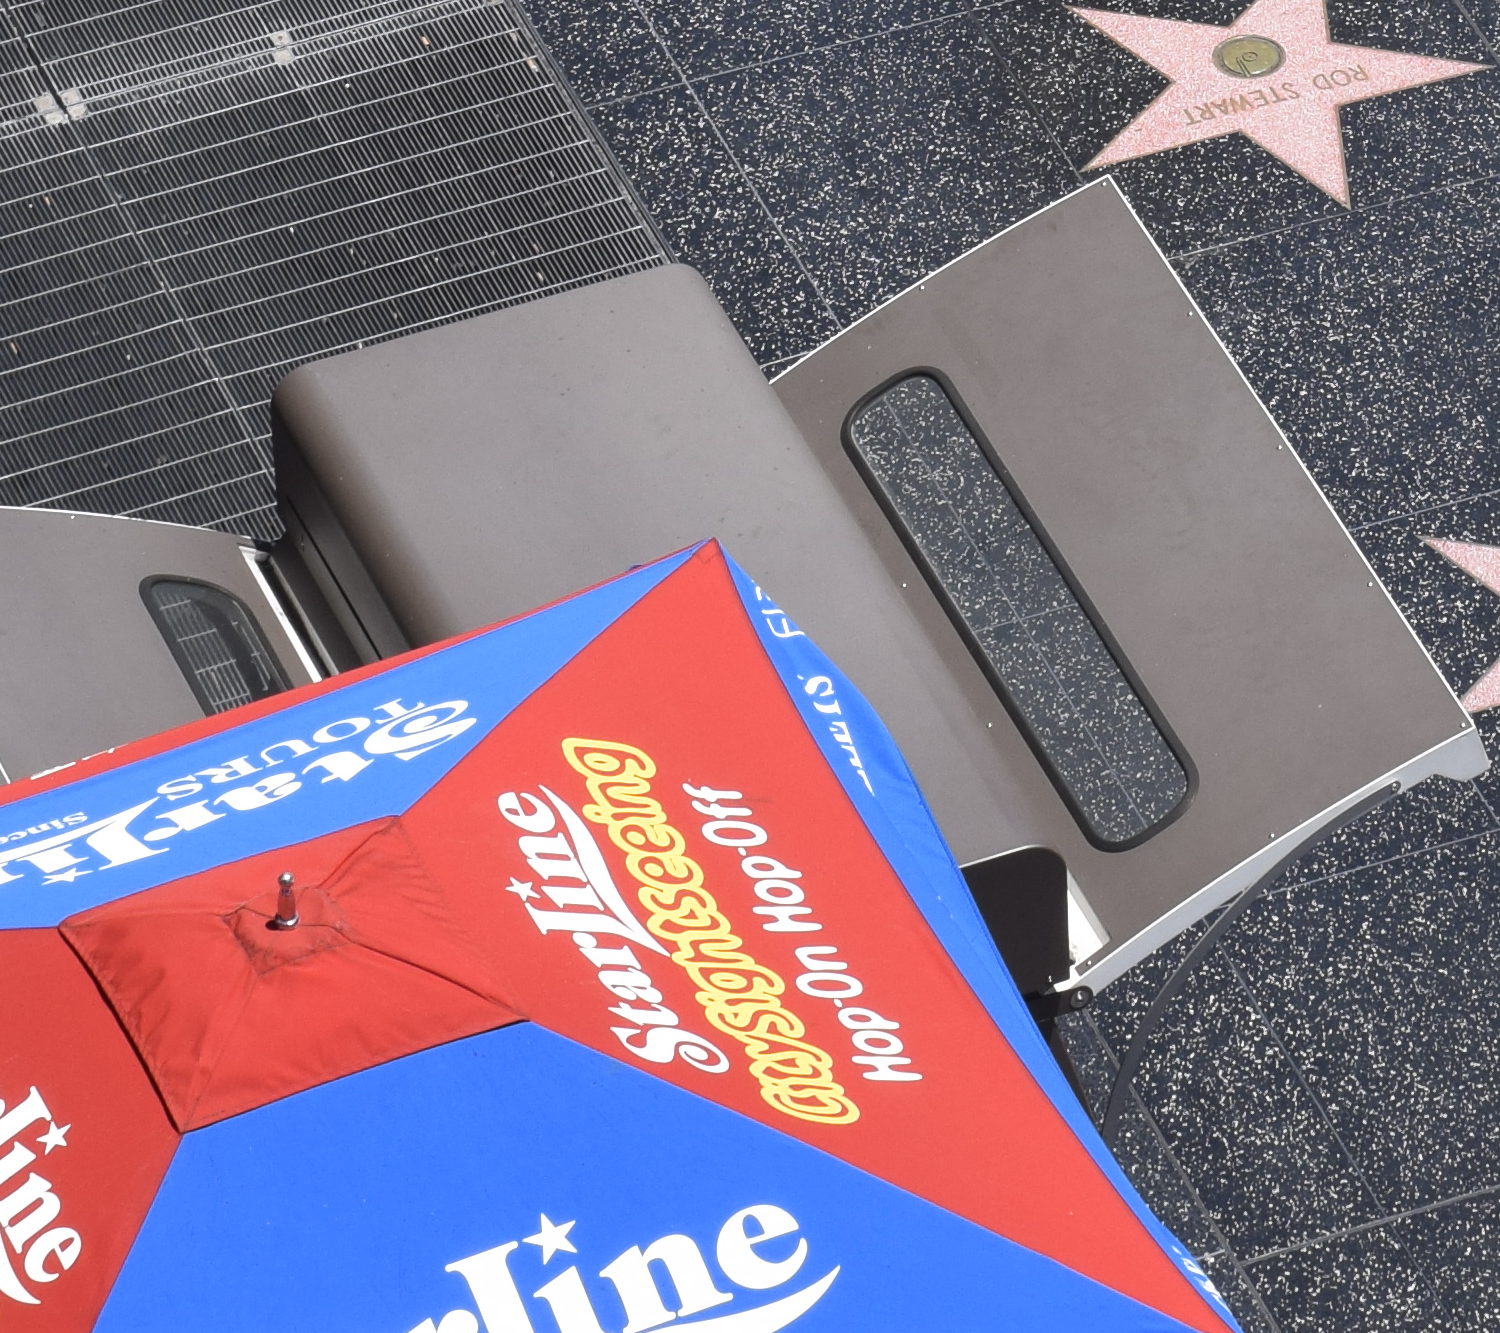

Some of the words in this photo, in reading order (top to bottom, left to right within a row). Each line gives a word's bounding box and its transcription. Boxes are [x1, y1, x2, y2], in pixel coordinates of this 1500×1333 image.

[1183, 81, 1301, 126] STEWART
[1312, 64, 1369, 92] ROD
[156, 698, 426, 801] TOURS
[682, 779, 823, 932] Hop-Off
[794, 945, 923, 1082] Hop-On
